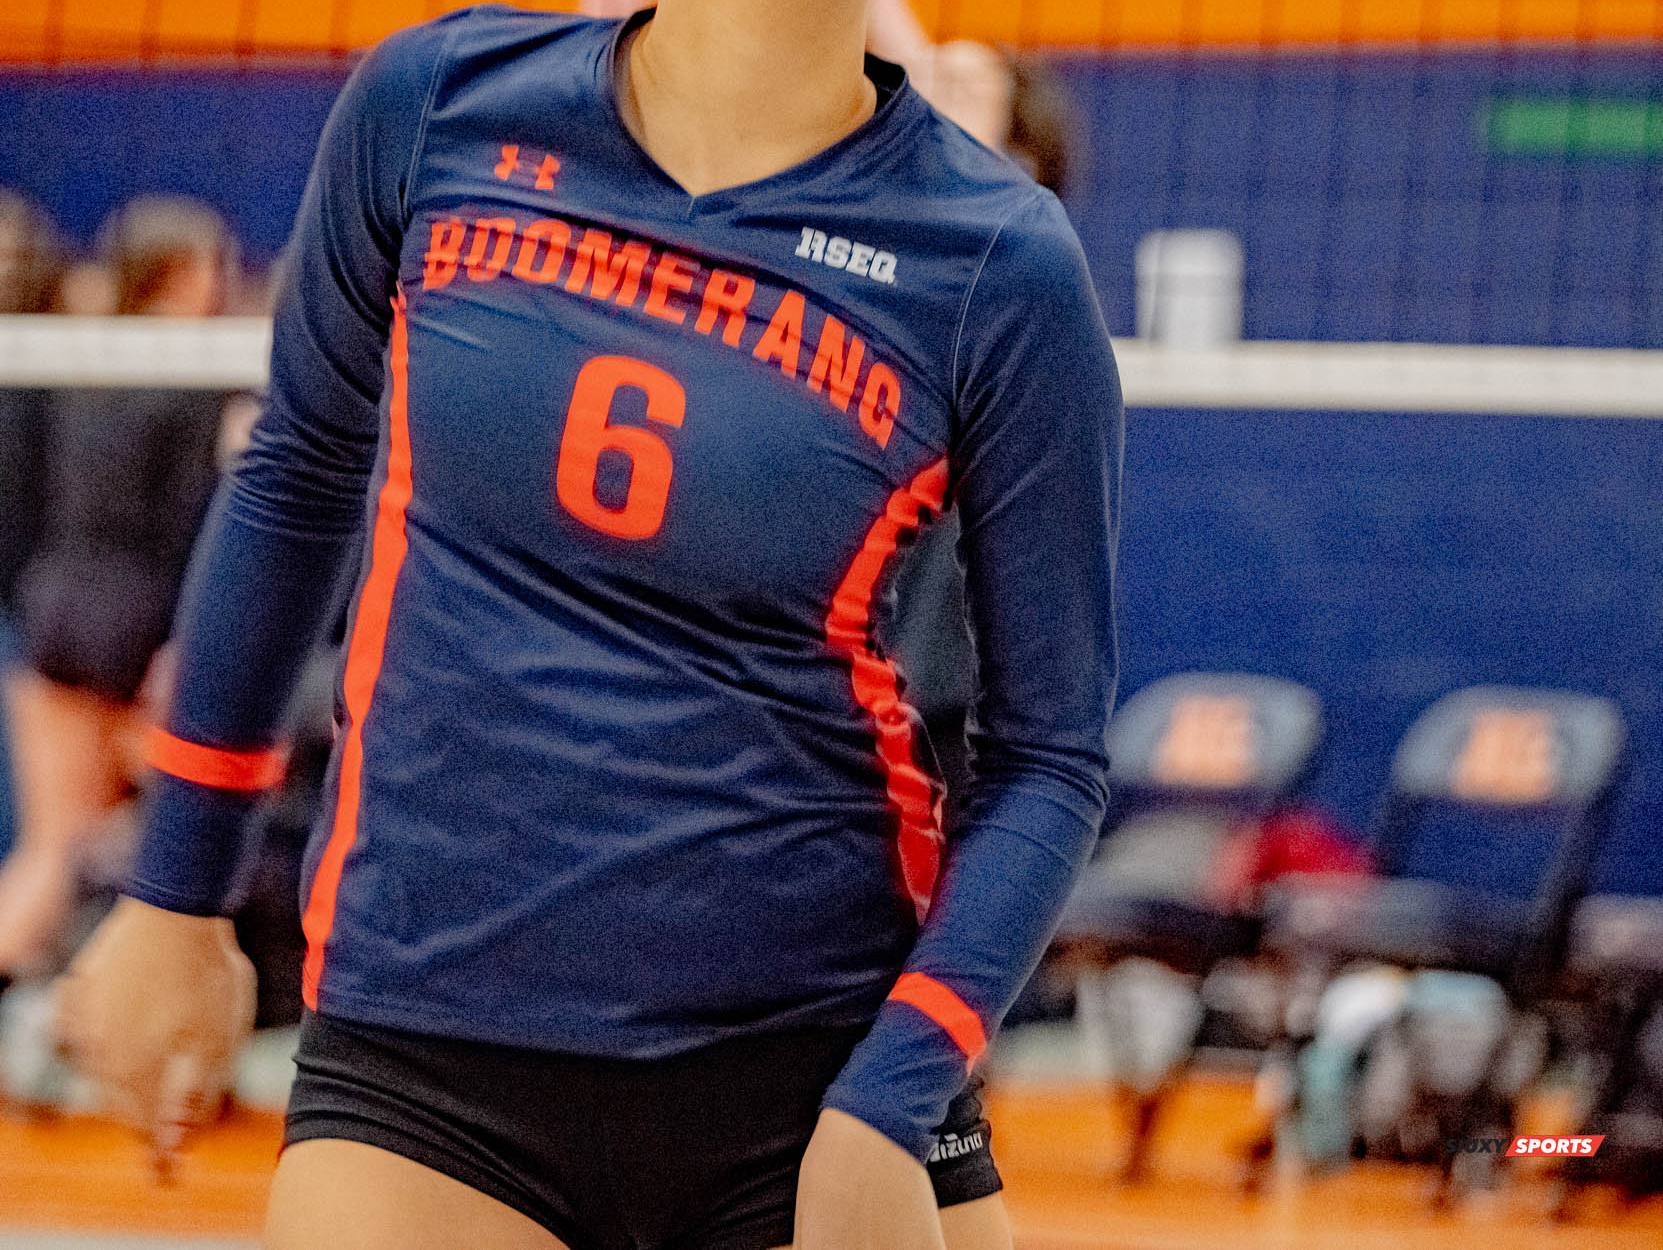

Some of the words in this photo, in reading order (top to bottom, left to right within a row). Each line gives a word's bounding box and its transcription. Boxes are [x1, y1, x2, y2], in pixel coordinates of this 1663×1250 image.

[422, 217, 901, 450] BOOMERANG
[794, 225, 898, 286] RSEQ
[556, 355, 686, 539] 6
